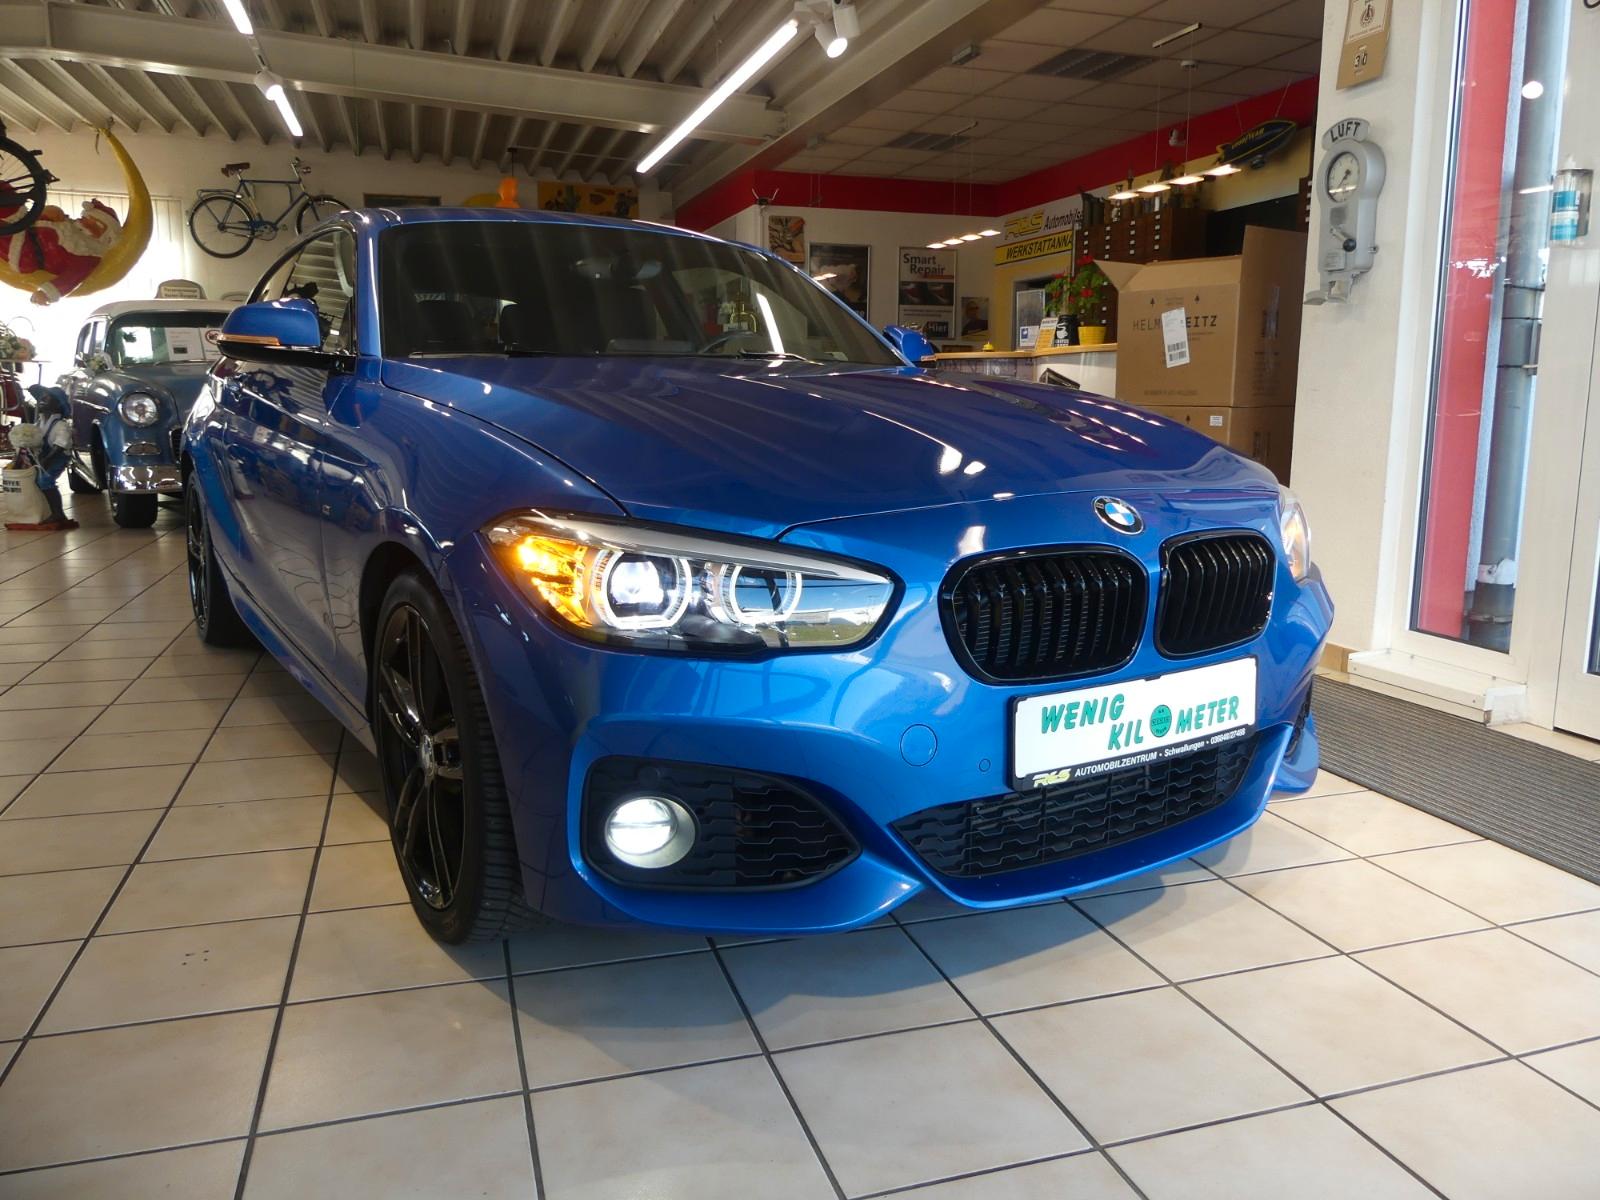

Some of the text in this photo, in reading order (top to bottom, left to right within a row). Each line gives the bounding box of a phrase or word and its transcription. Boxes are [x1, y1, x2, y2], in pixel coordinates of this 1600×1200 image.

[1330, 121, 1361, 142] LUFT
[903, 253, 937, 265] Smart
[910, 264, 946, 277] Repair
[1041, 693, 1125, 734] WENIG
[1075, 751, 1158, 778] AUTOMOBILZENTRUM
